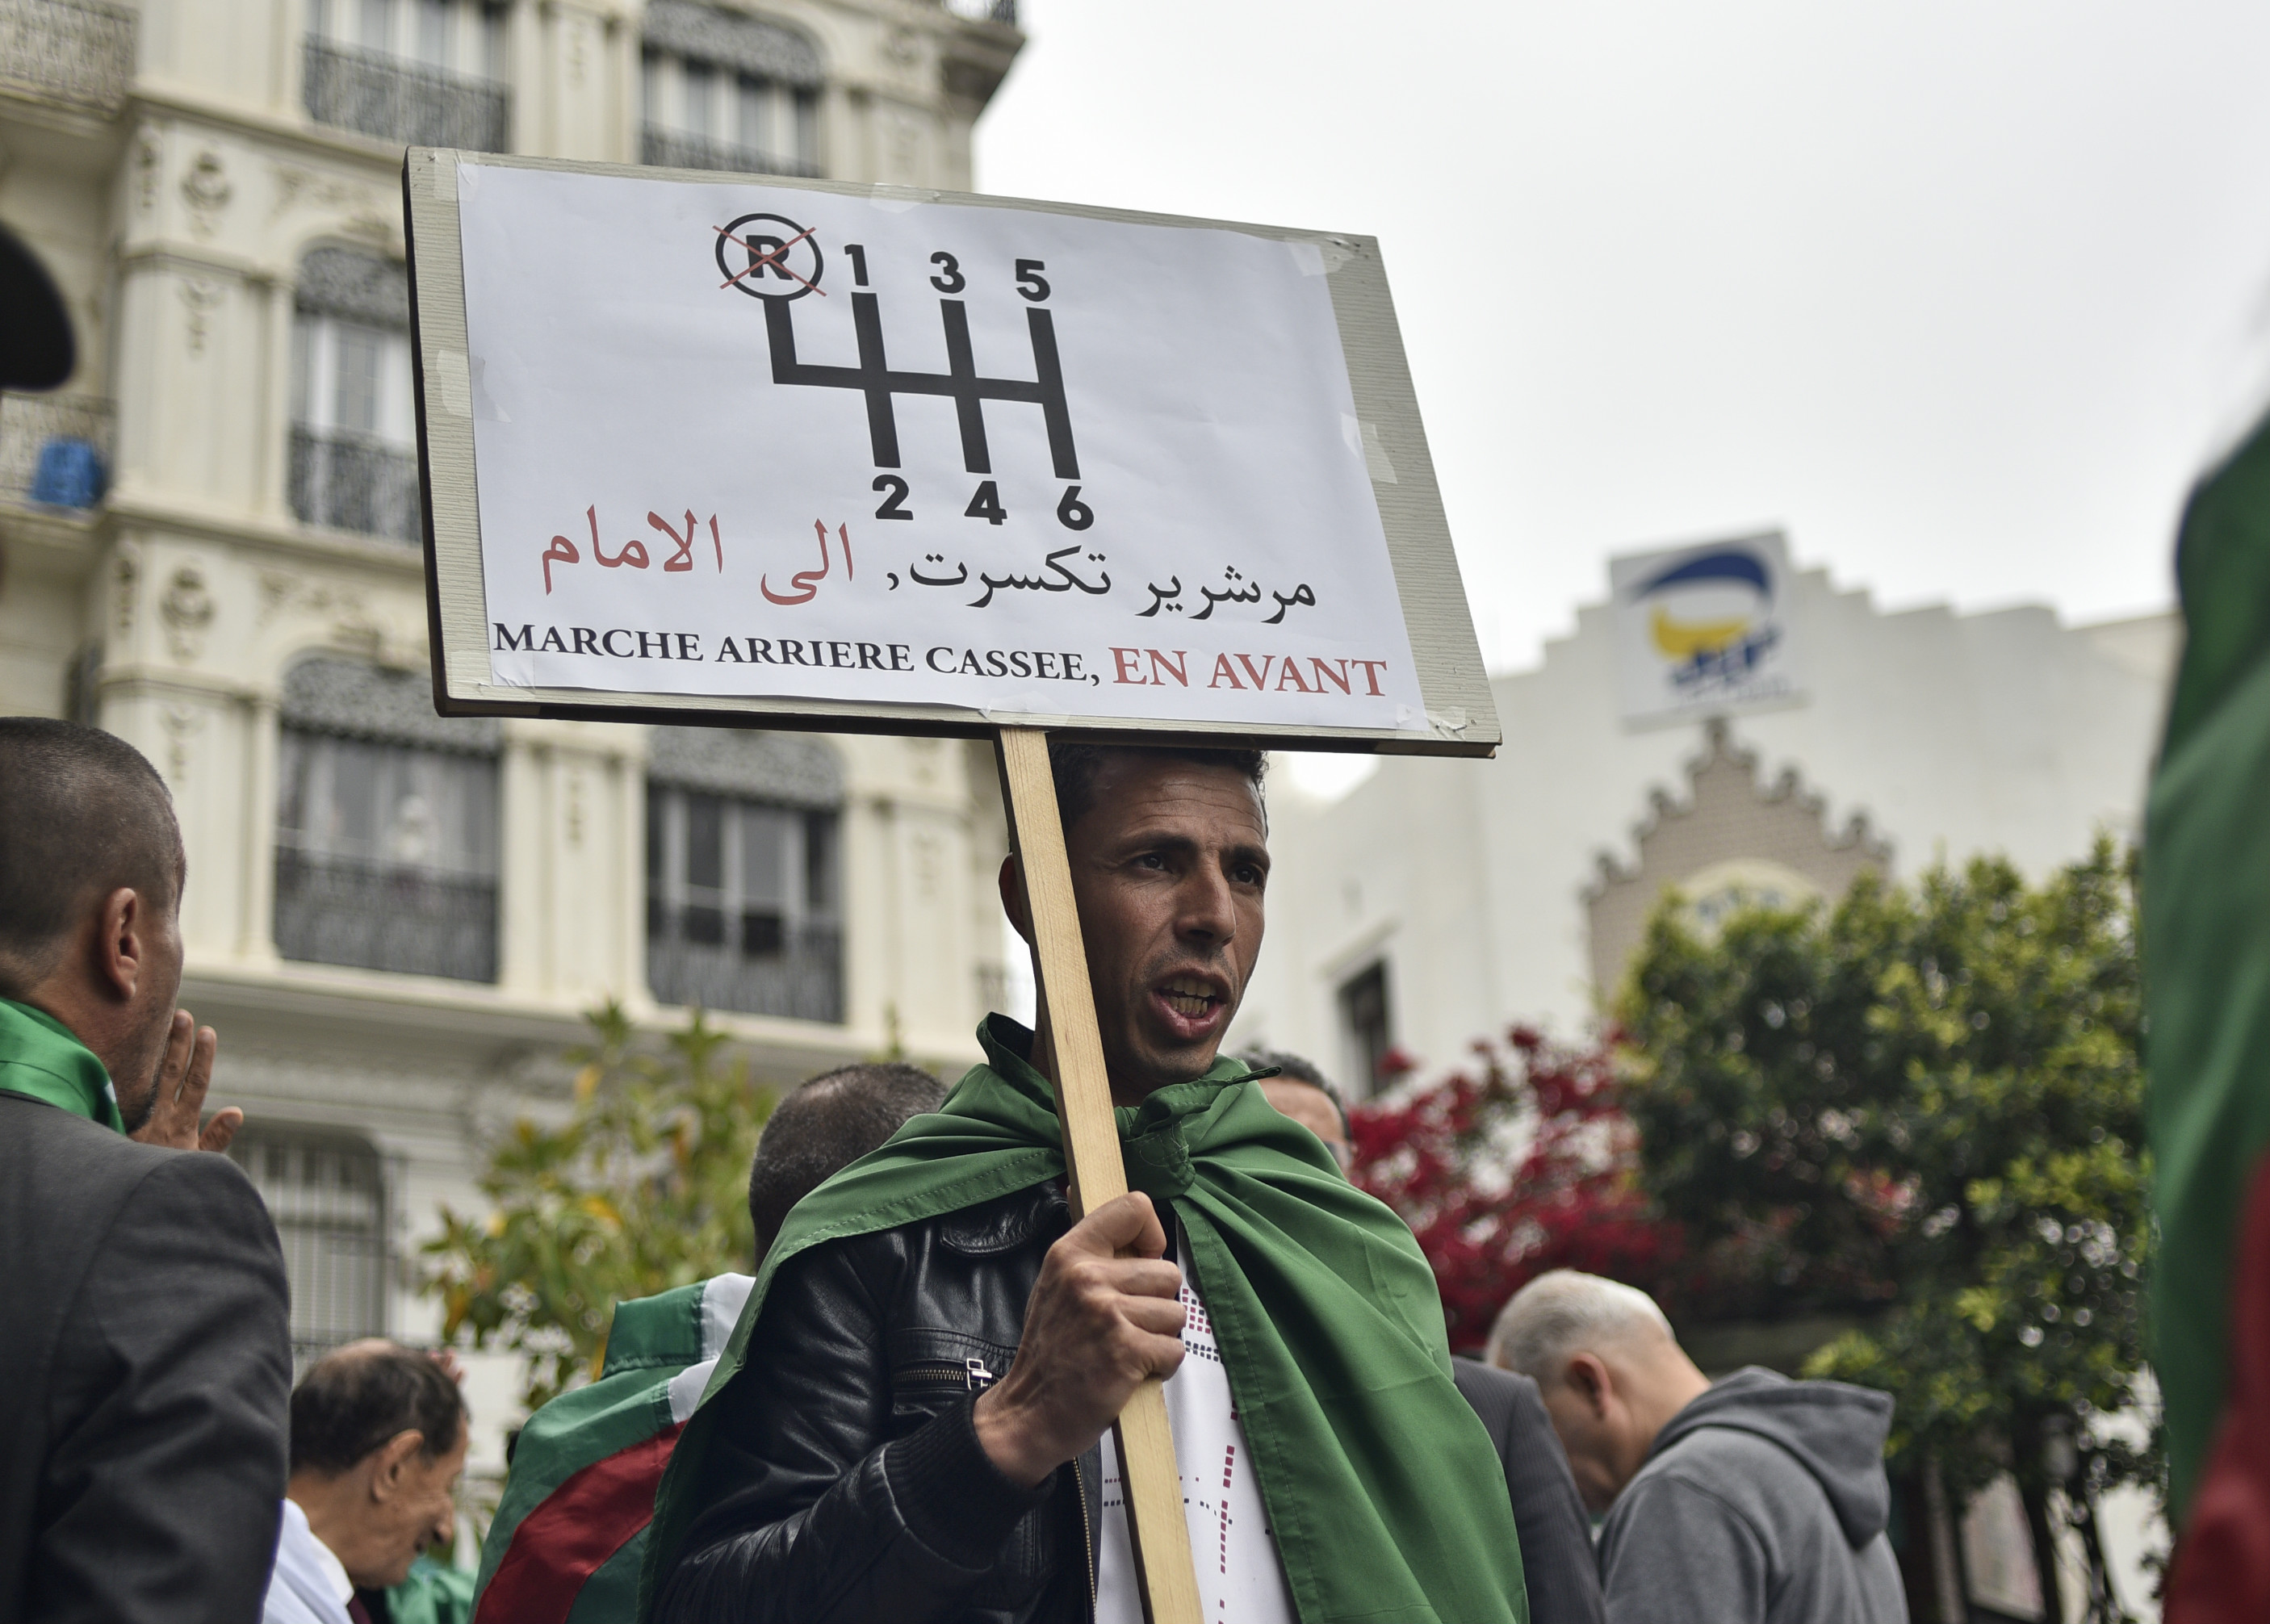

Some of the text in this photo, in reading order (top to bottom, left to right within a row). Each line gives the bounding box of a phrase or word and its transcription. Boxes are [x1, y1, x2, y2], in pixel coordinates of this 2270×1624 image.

[746, 234, 1051, 303] R 1 3 5
[872, 474, 1095, 531] 2 4 6
[542, 503, 723, 596] الامام
[760, 517, 854, 606] الى
[492, 622, 1388, 697] MARCHE ARRIERE CASSEE, EN AVANT
